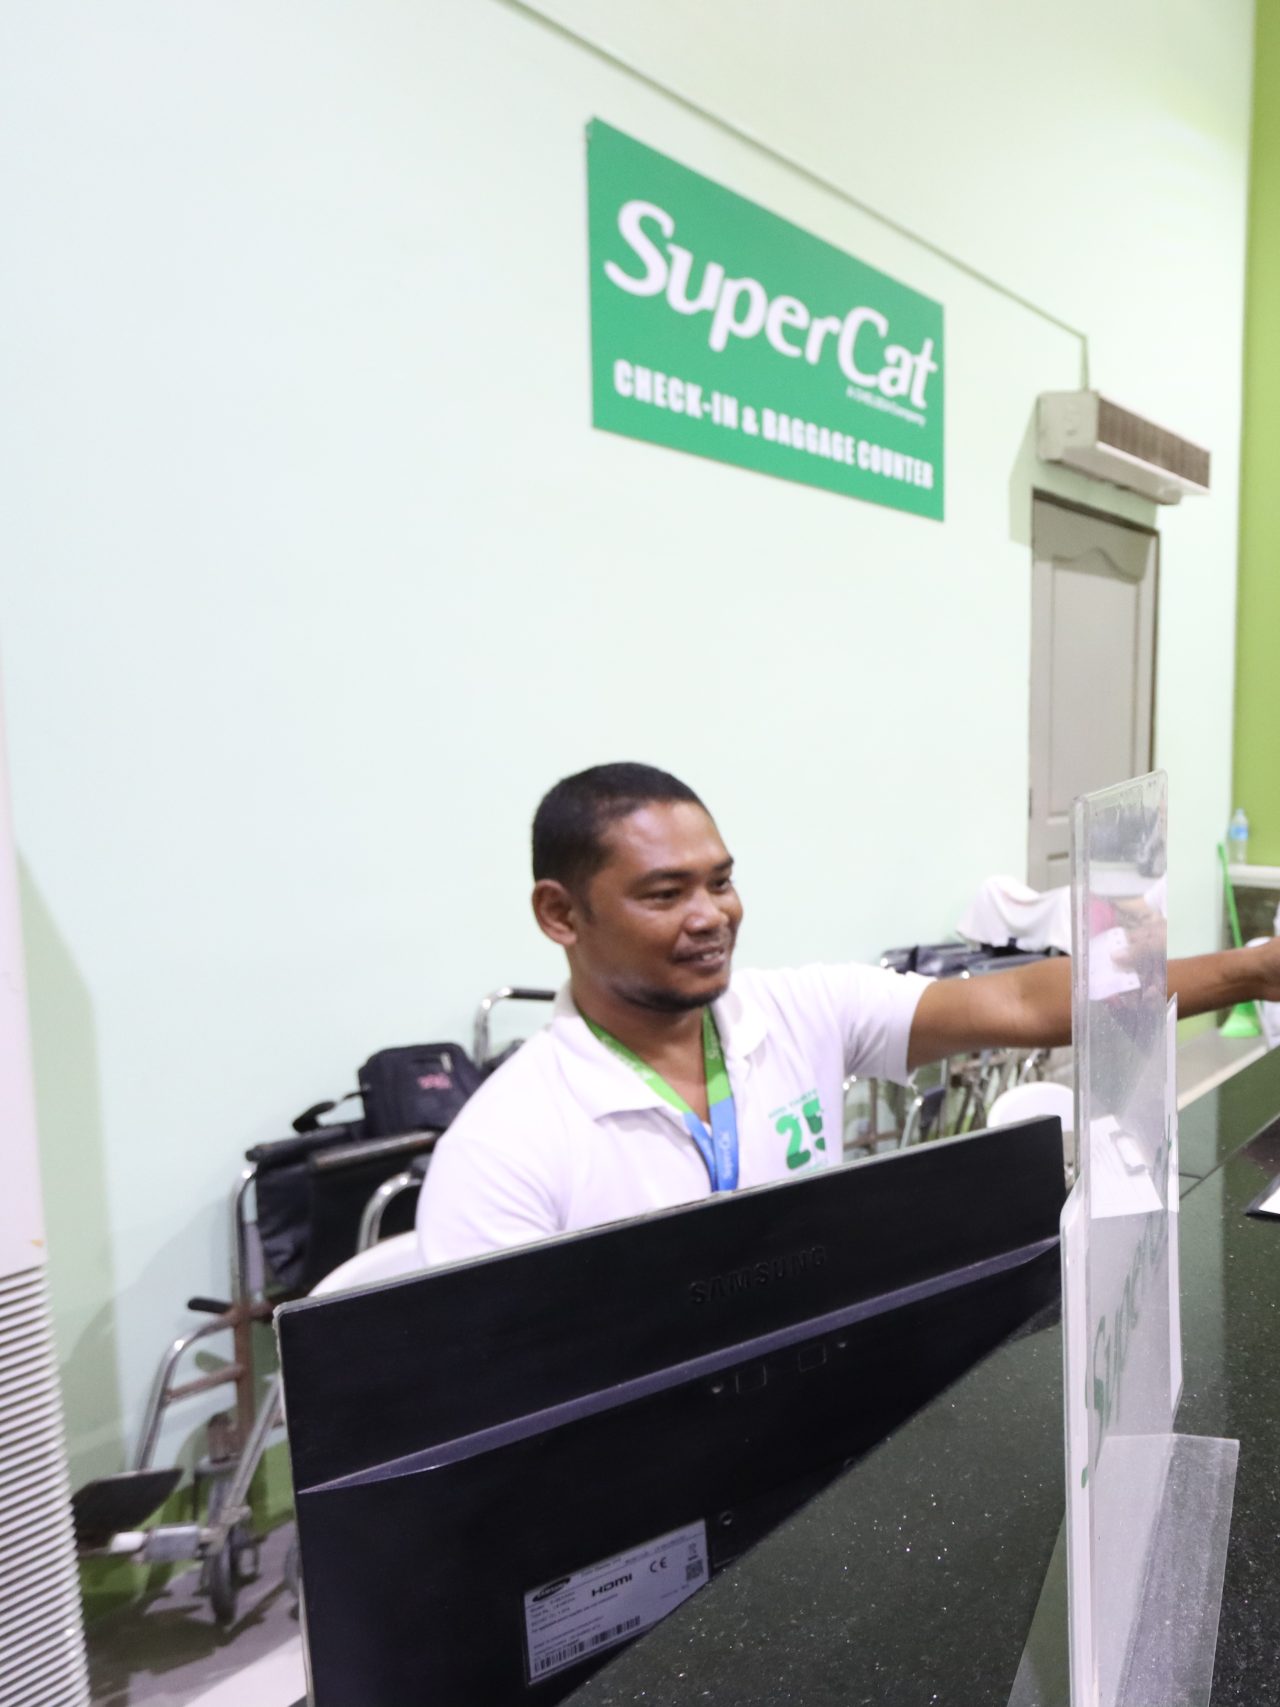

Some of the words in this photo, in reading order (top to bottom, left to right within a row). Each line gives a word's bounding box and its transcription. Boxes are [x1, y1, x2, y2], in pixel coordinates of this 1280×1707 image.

[604, 199, 939, 409] SuperCat
[613, 359, 739, 429] CHECK-IN
[741, 406, 759, 436] &
[762, 408, 855, 465] BAGGAGE
[857, 440, 934, 489] COUNTER
